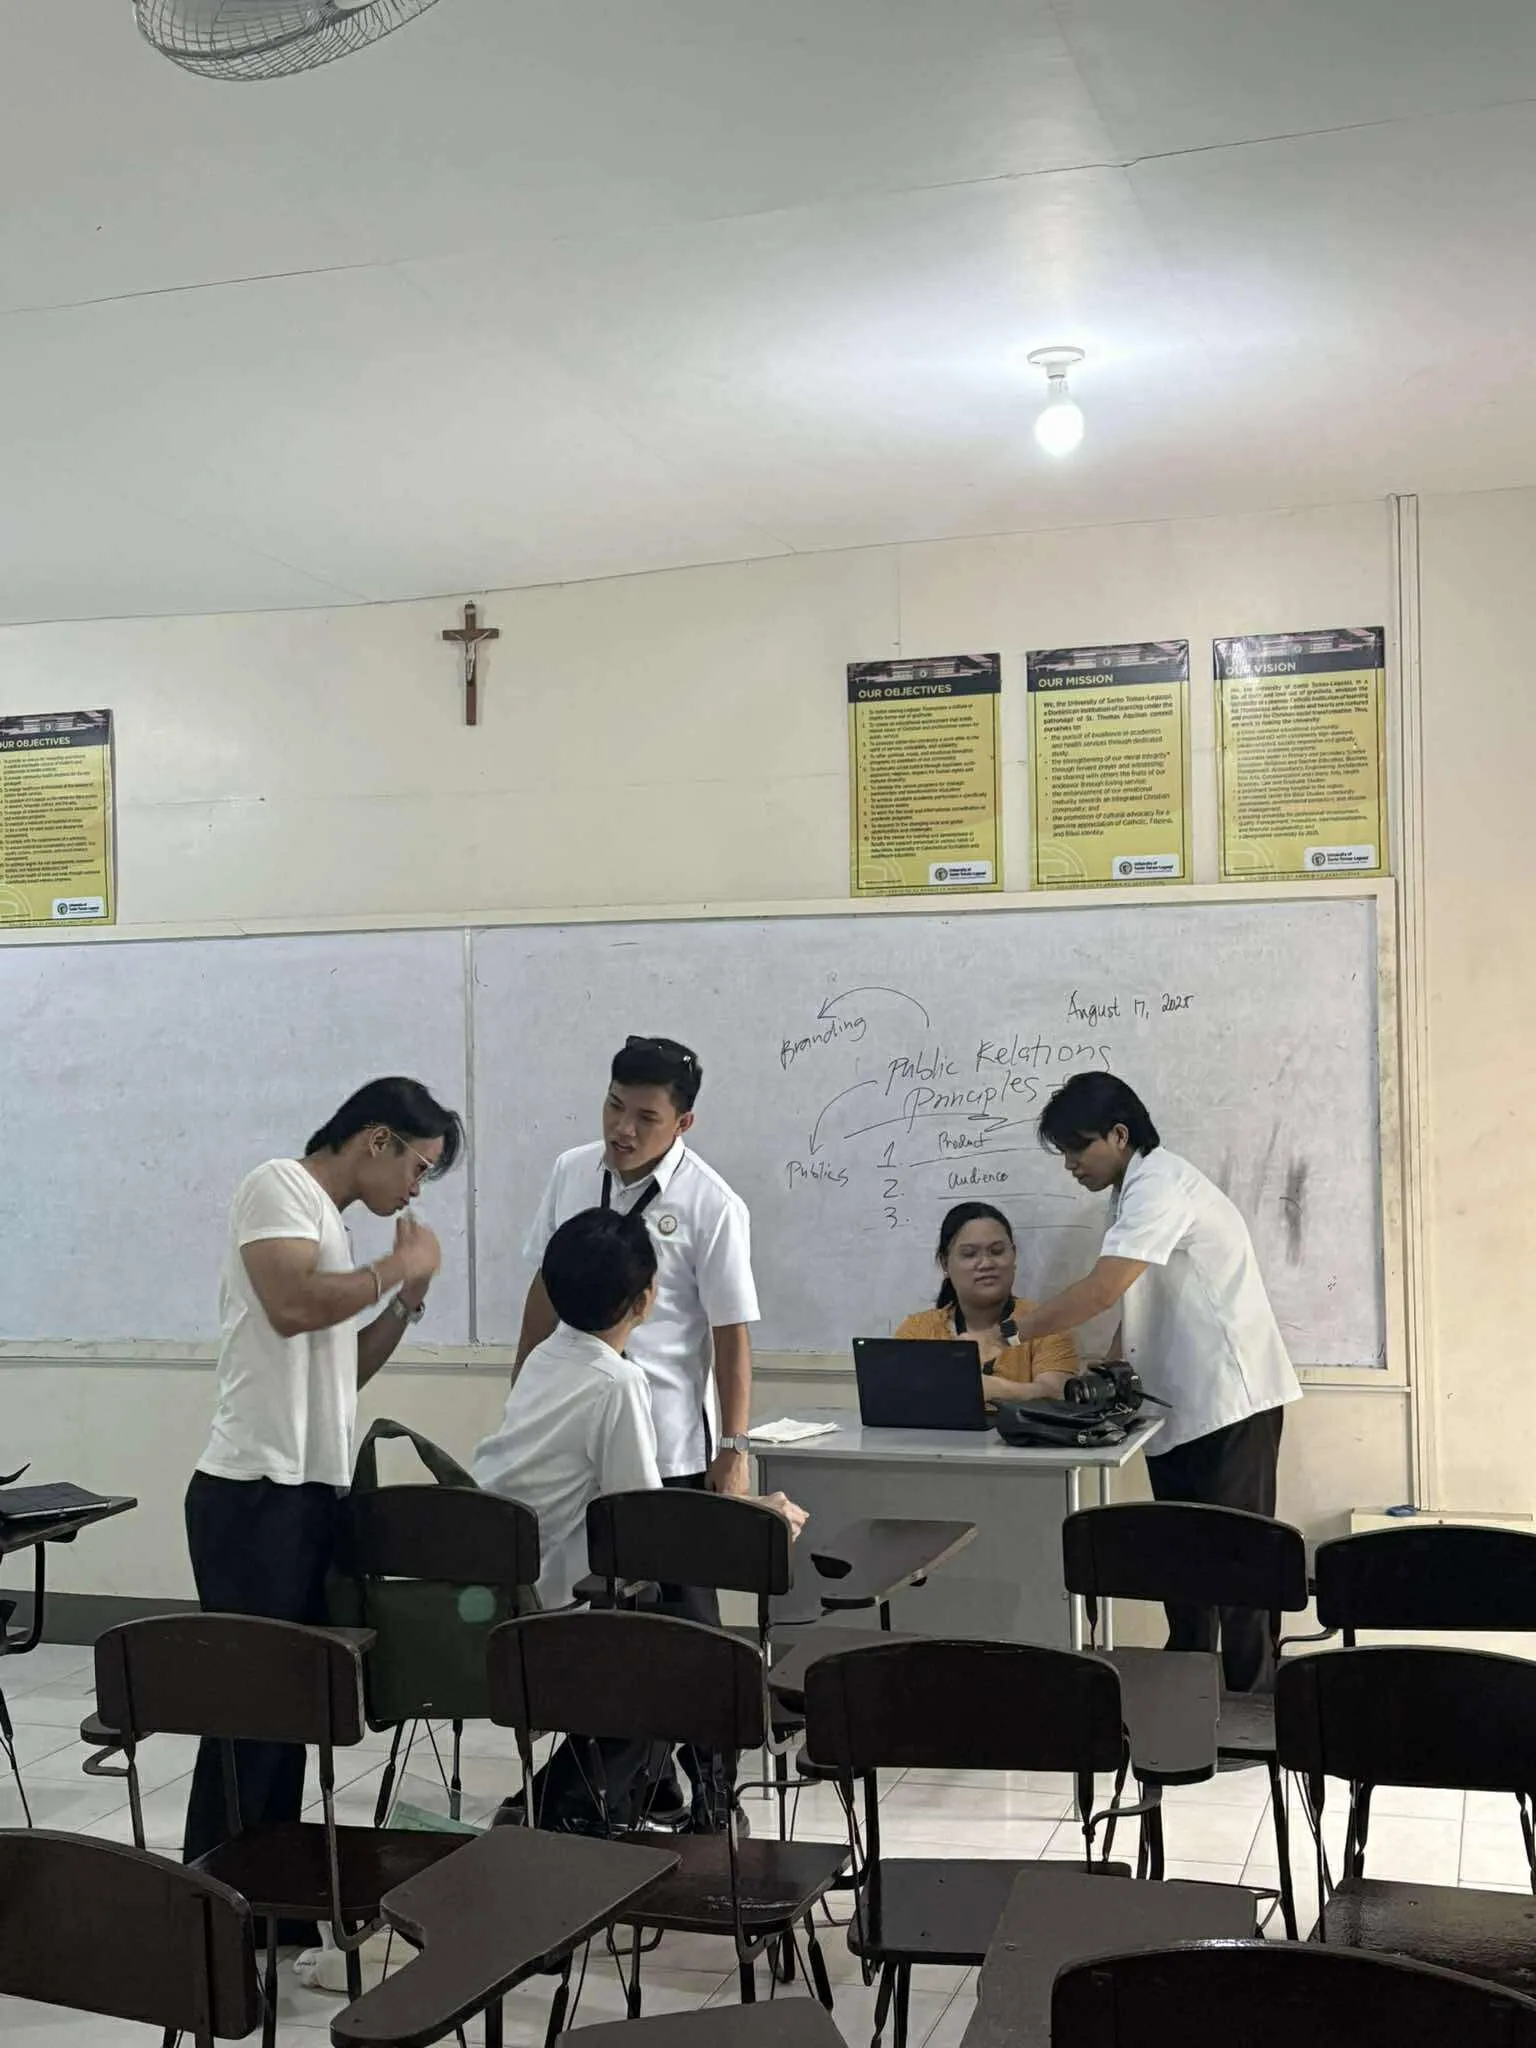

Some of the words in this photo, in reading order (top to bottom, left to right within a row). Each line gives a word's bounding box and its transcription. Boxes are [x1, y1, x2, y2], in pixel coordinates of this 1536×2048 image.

[1254, 662, 1296, 673] VISION
[858, 689, 883, 699] OUR
[884, 684, 952, 697] OBJECTIVES
[1038, 678, 1063, 688] OUR
[1066, 674, 1113, 686] MISSION
[17, 736, 71, 748] OBJECTIVES
[1067, 990, 1121, 1027] August
[1161, 992, 1196, 1013] 2025
[780, 1016, 867, 1071] Branding
[884, 1046, 960, 1096] Public
[975, 1034, 1112, 1073] Relations
[939, 1131, 992, 1152] Product
[783, 1160, 849, 1190] Publics
[883, 1179, 905, 1199] 2.
[884, 1207, 911, 1229] 3.
